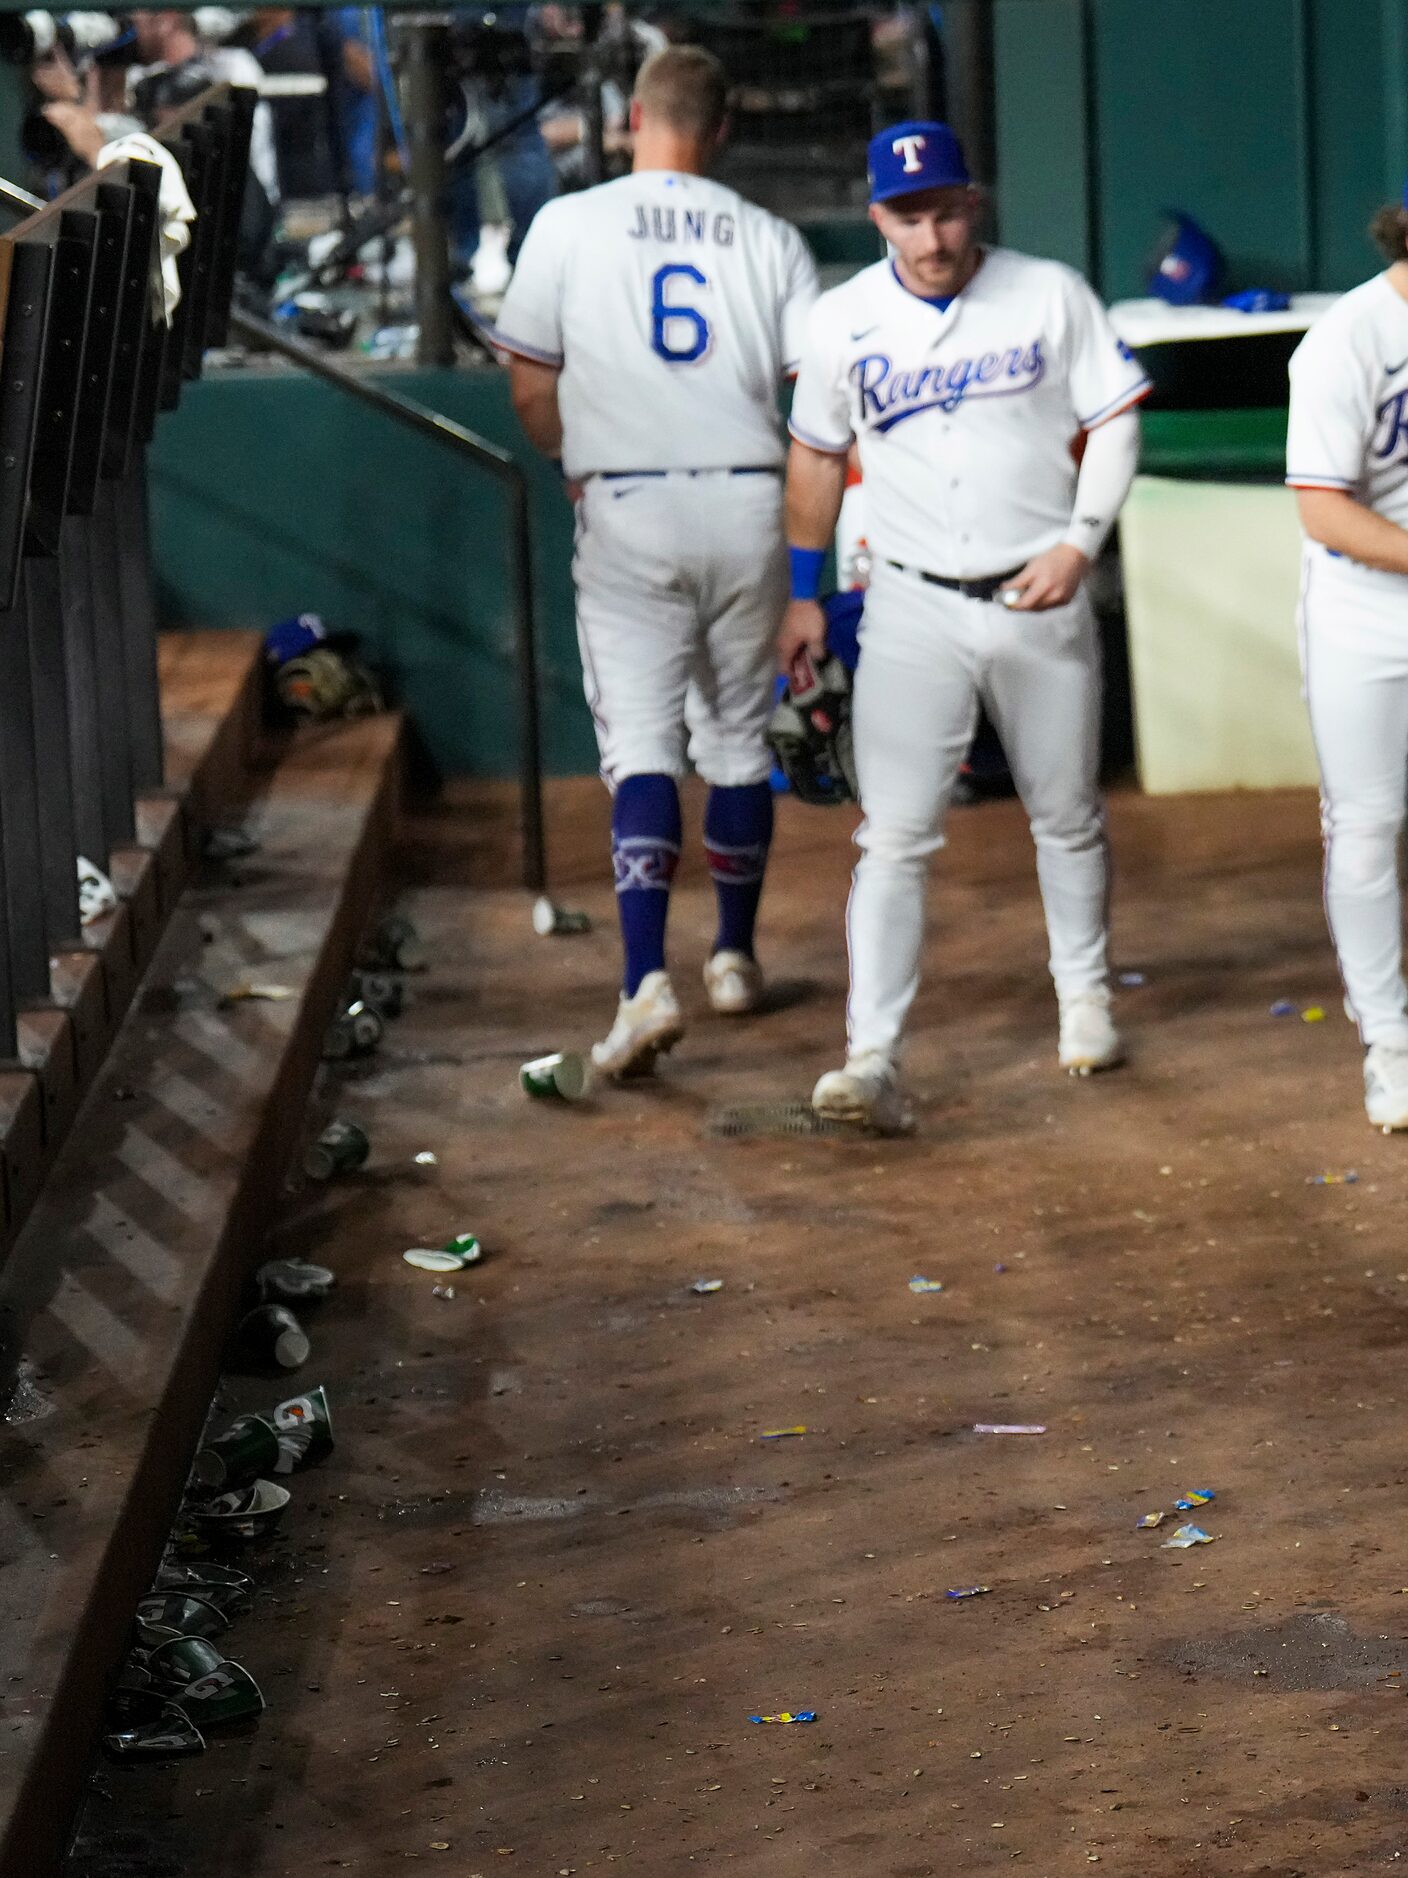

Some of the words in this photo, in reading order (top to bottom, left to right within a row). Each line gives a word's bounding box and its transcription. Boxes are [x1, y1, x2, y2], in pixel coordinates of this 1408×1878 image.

[892, 134, 926, 174] T
[628, 205, 735, 247] JUNG
[652, 263, 713, 365] 6
[849, 339, 1046, 420] Rangers
